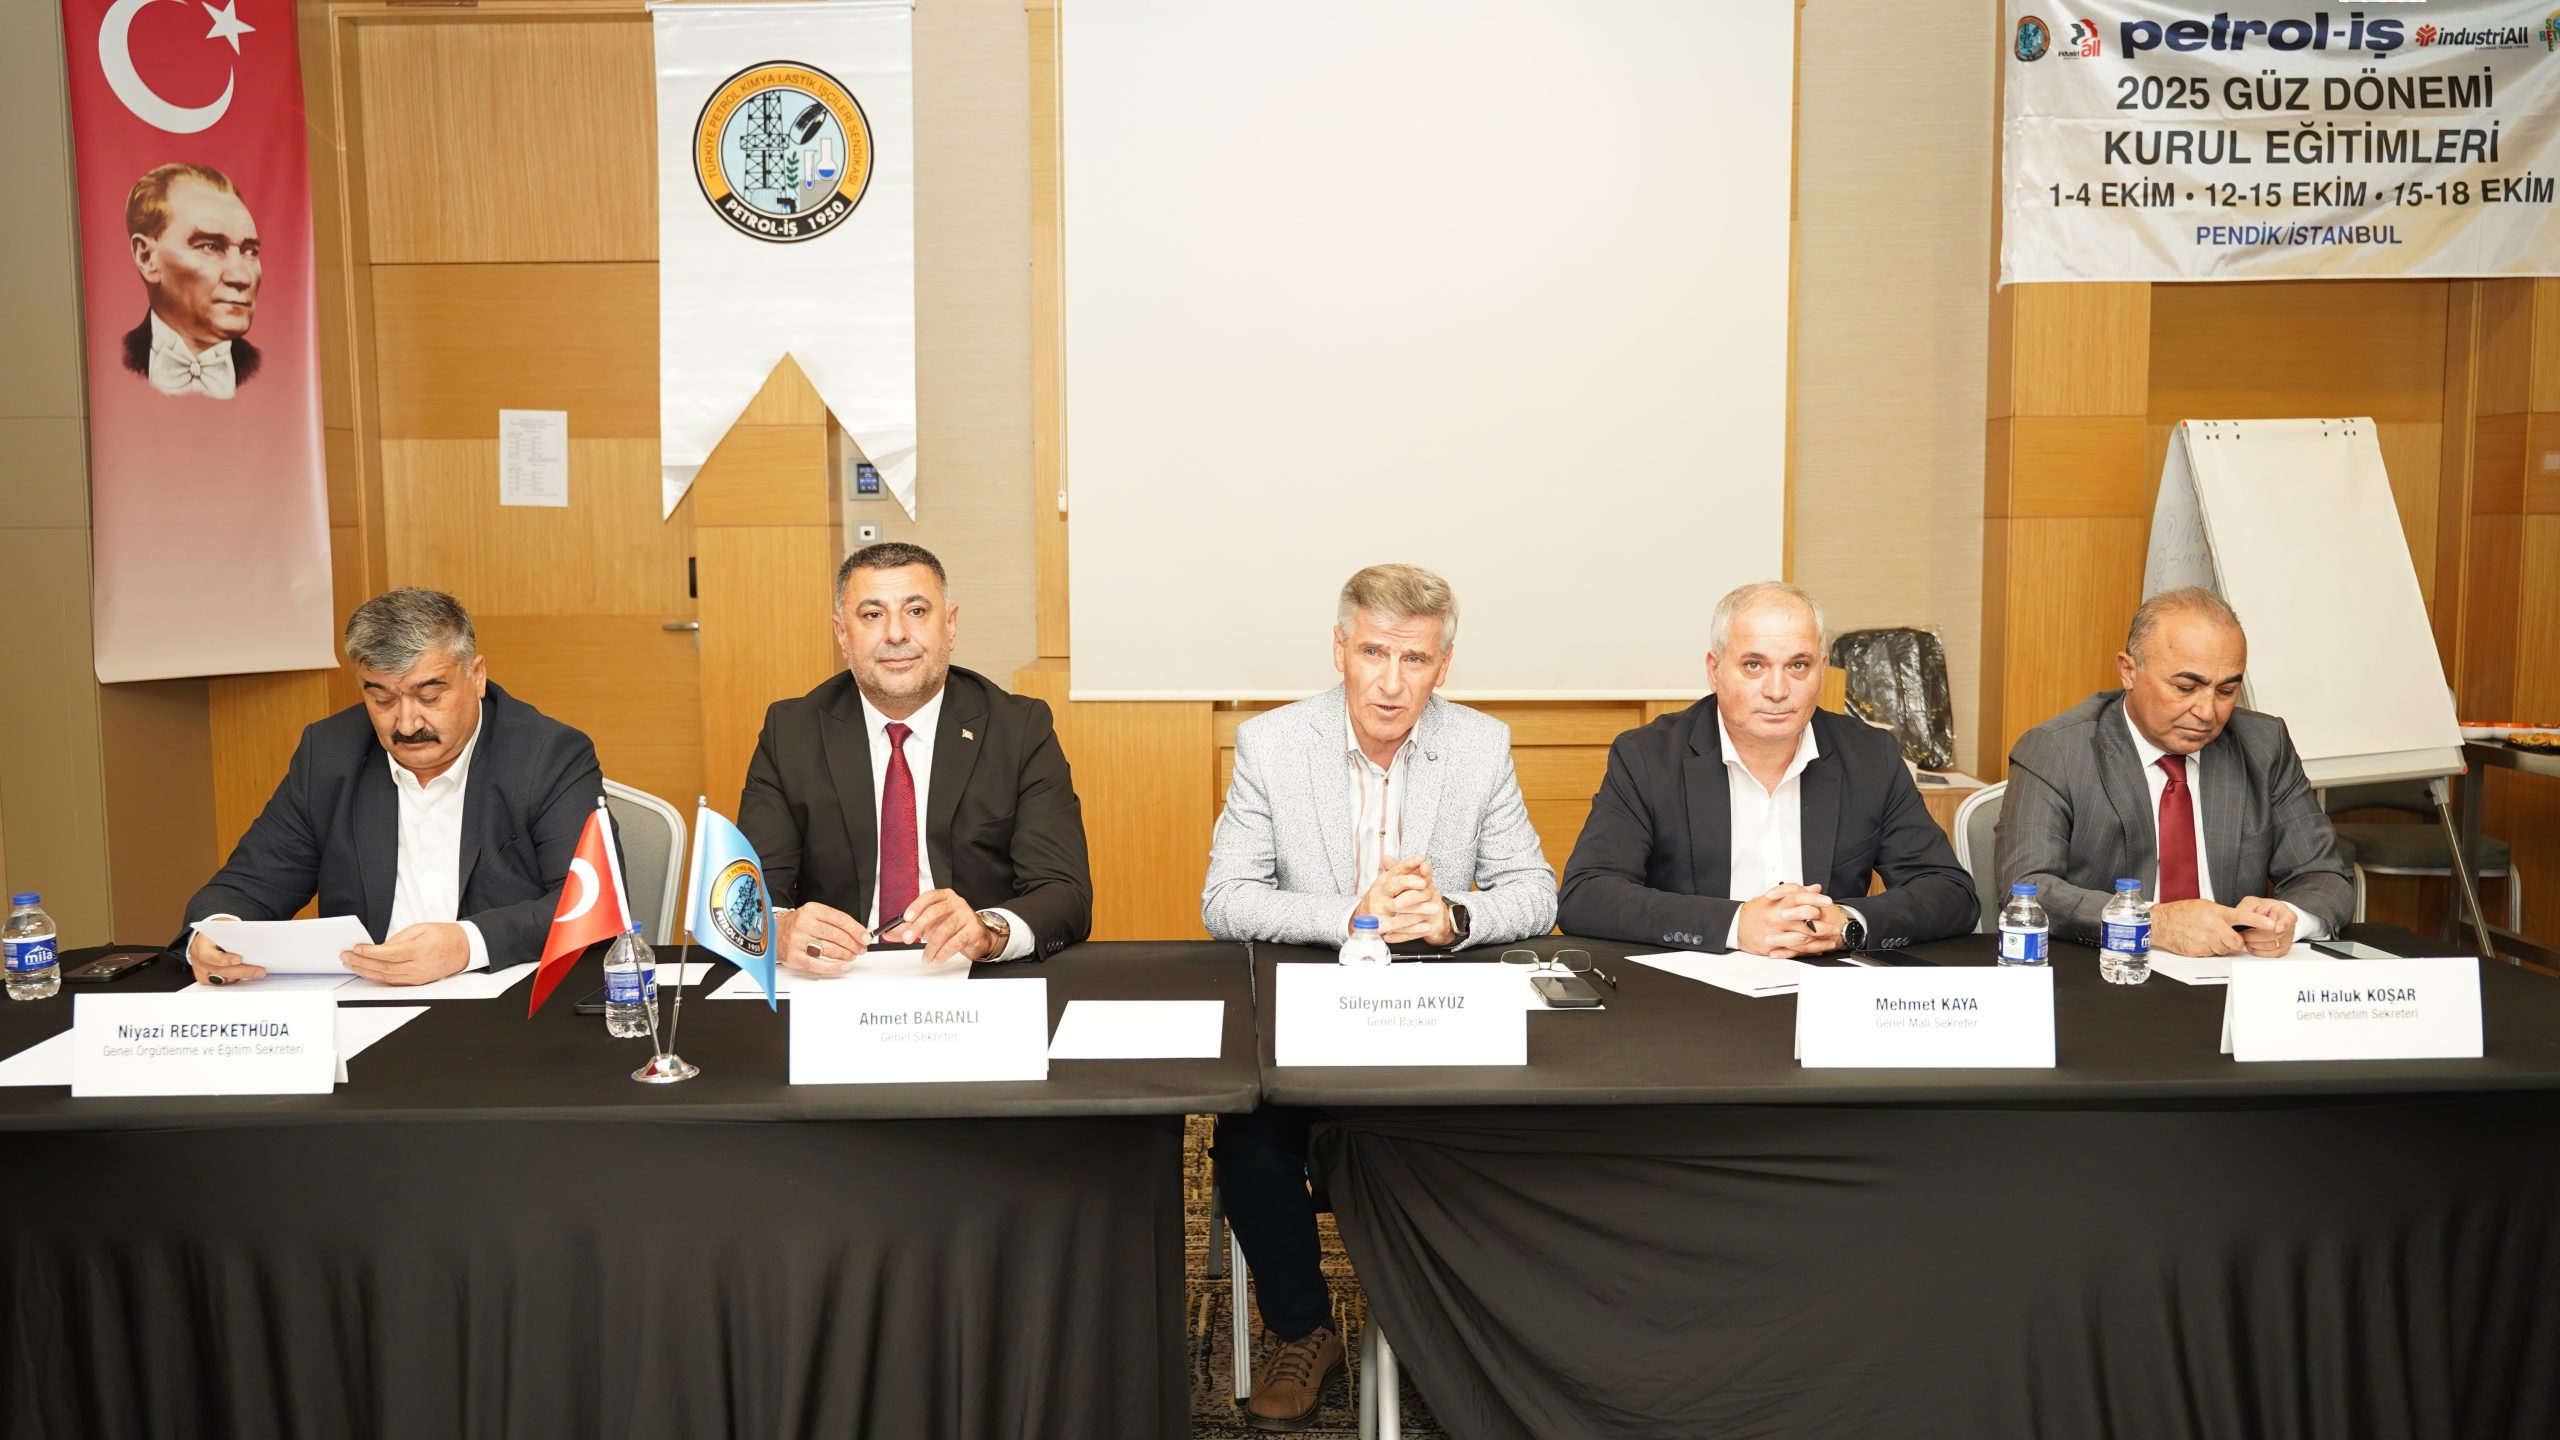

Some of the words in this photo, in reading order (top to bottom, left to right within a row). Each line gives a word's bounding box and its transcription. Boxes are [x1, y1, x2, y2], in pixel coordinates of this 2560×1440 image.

[2120, 12, 2404, 59] petrol-iş
[2437, 26, 2528, 46] industriAll
[740, 74, 776, 92] KİMYA
[778, 74, 817, 89] LASTİK
[2116, 75, 2210, 110] 2025
[2223, 69, 2310, 111] GÜZ
[2324, 66, 2493, 111] DÖNEMİ
[709, 91, 740, 129] PETROL
[2105, 130, 2252, 165] KURUL
[2266, 120, 2500, 165] EĞİTİMLERİ
[703, 130, 718, 179] TÜRKİYE
[848, 124, 864, 186] SENDİKASI
[2049, 182, 2091, 207] 1-4
[2101, 176, 2175, 207] EKİM
[2205, 182, 2282, 207] 12-15
[2293, 176, 2367, 207] EKİM
[2393, 181, 2470, 207] 15-18
[2481, 171, 2555, 204] EKİM
[724, 198, 798, 237] PETROL-İŞ
[807, 200, 845, 230] 1950
[2196, 221, 2403, 246] PENDİK/İSTANBUL
[25, 950, 53, 964] mila
[1339, 995, 1412, 1012] Süleyman
[1417, 992, 1465, 1010] AKYÜZ
[1876, 998, 1936, 1011] Mehmet
[1941, 998, 1978, 1011] KAYA
[2297, 990, 2315, 1003] Ali
[2321, 989, 2362, 1003] Haluk
[2367, 988, 2416, 1005] KOŞAR
[860, 1012, 908, 1025] Ahmet
[914, 1010, 978, 1024] BARANLI
[1367, 1016, 1396, 1027] Genel
[1876, 1018, 1905, 1028] Genel
[2296, 1009, 2325, 1021] Genel
[2328, 1009, 2368, 1020] Yönetim
[2371, 1008, 2418, 1019] Sekreteri
[118, 1024, 165, 1042] Niyazi
[170, 1019, 290, 1038] RECEPKETHÜDA
[880, 1031, 910, 1043] Genel
[103, 1045, 133, 1057] Genel
[137, 1043, 199, 1058] Örgütlenme
[203, 1047, 214, 1056] ve
[256, 1043, 304, 1055] Sekreteri
